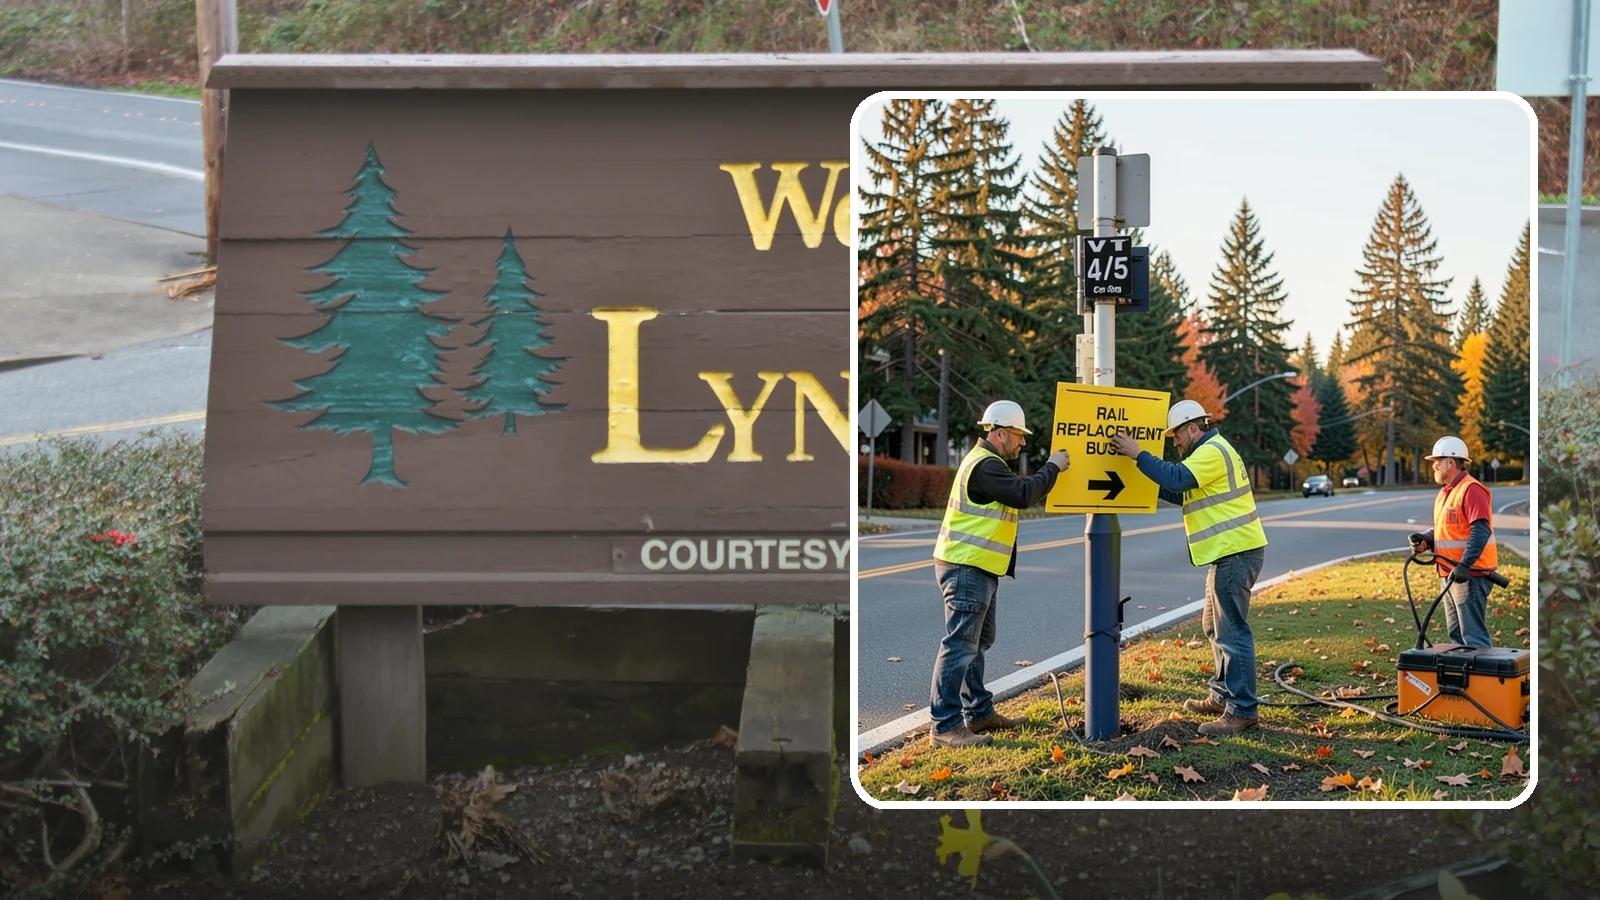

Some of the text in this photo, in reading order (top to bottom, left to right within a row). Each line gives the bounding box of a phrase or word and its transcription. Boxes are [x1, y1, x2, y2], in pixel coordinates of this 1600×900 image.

[1087, 256, 1129, 281] 4/5
[1096, 406, 1129, 421] RAIL
[1056, 422, 1165, 441] REPLACEMENT
[1086, 441, 1128, 457] BUS
[640, 539, 850, 570] COURTESY
